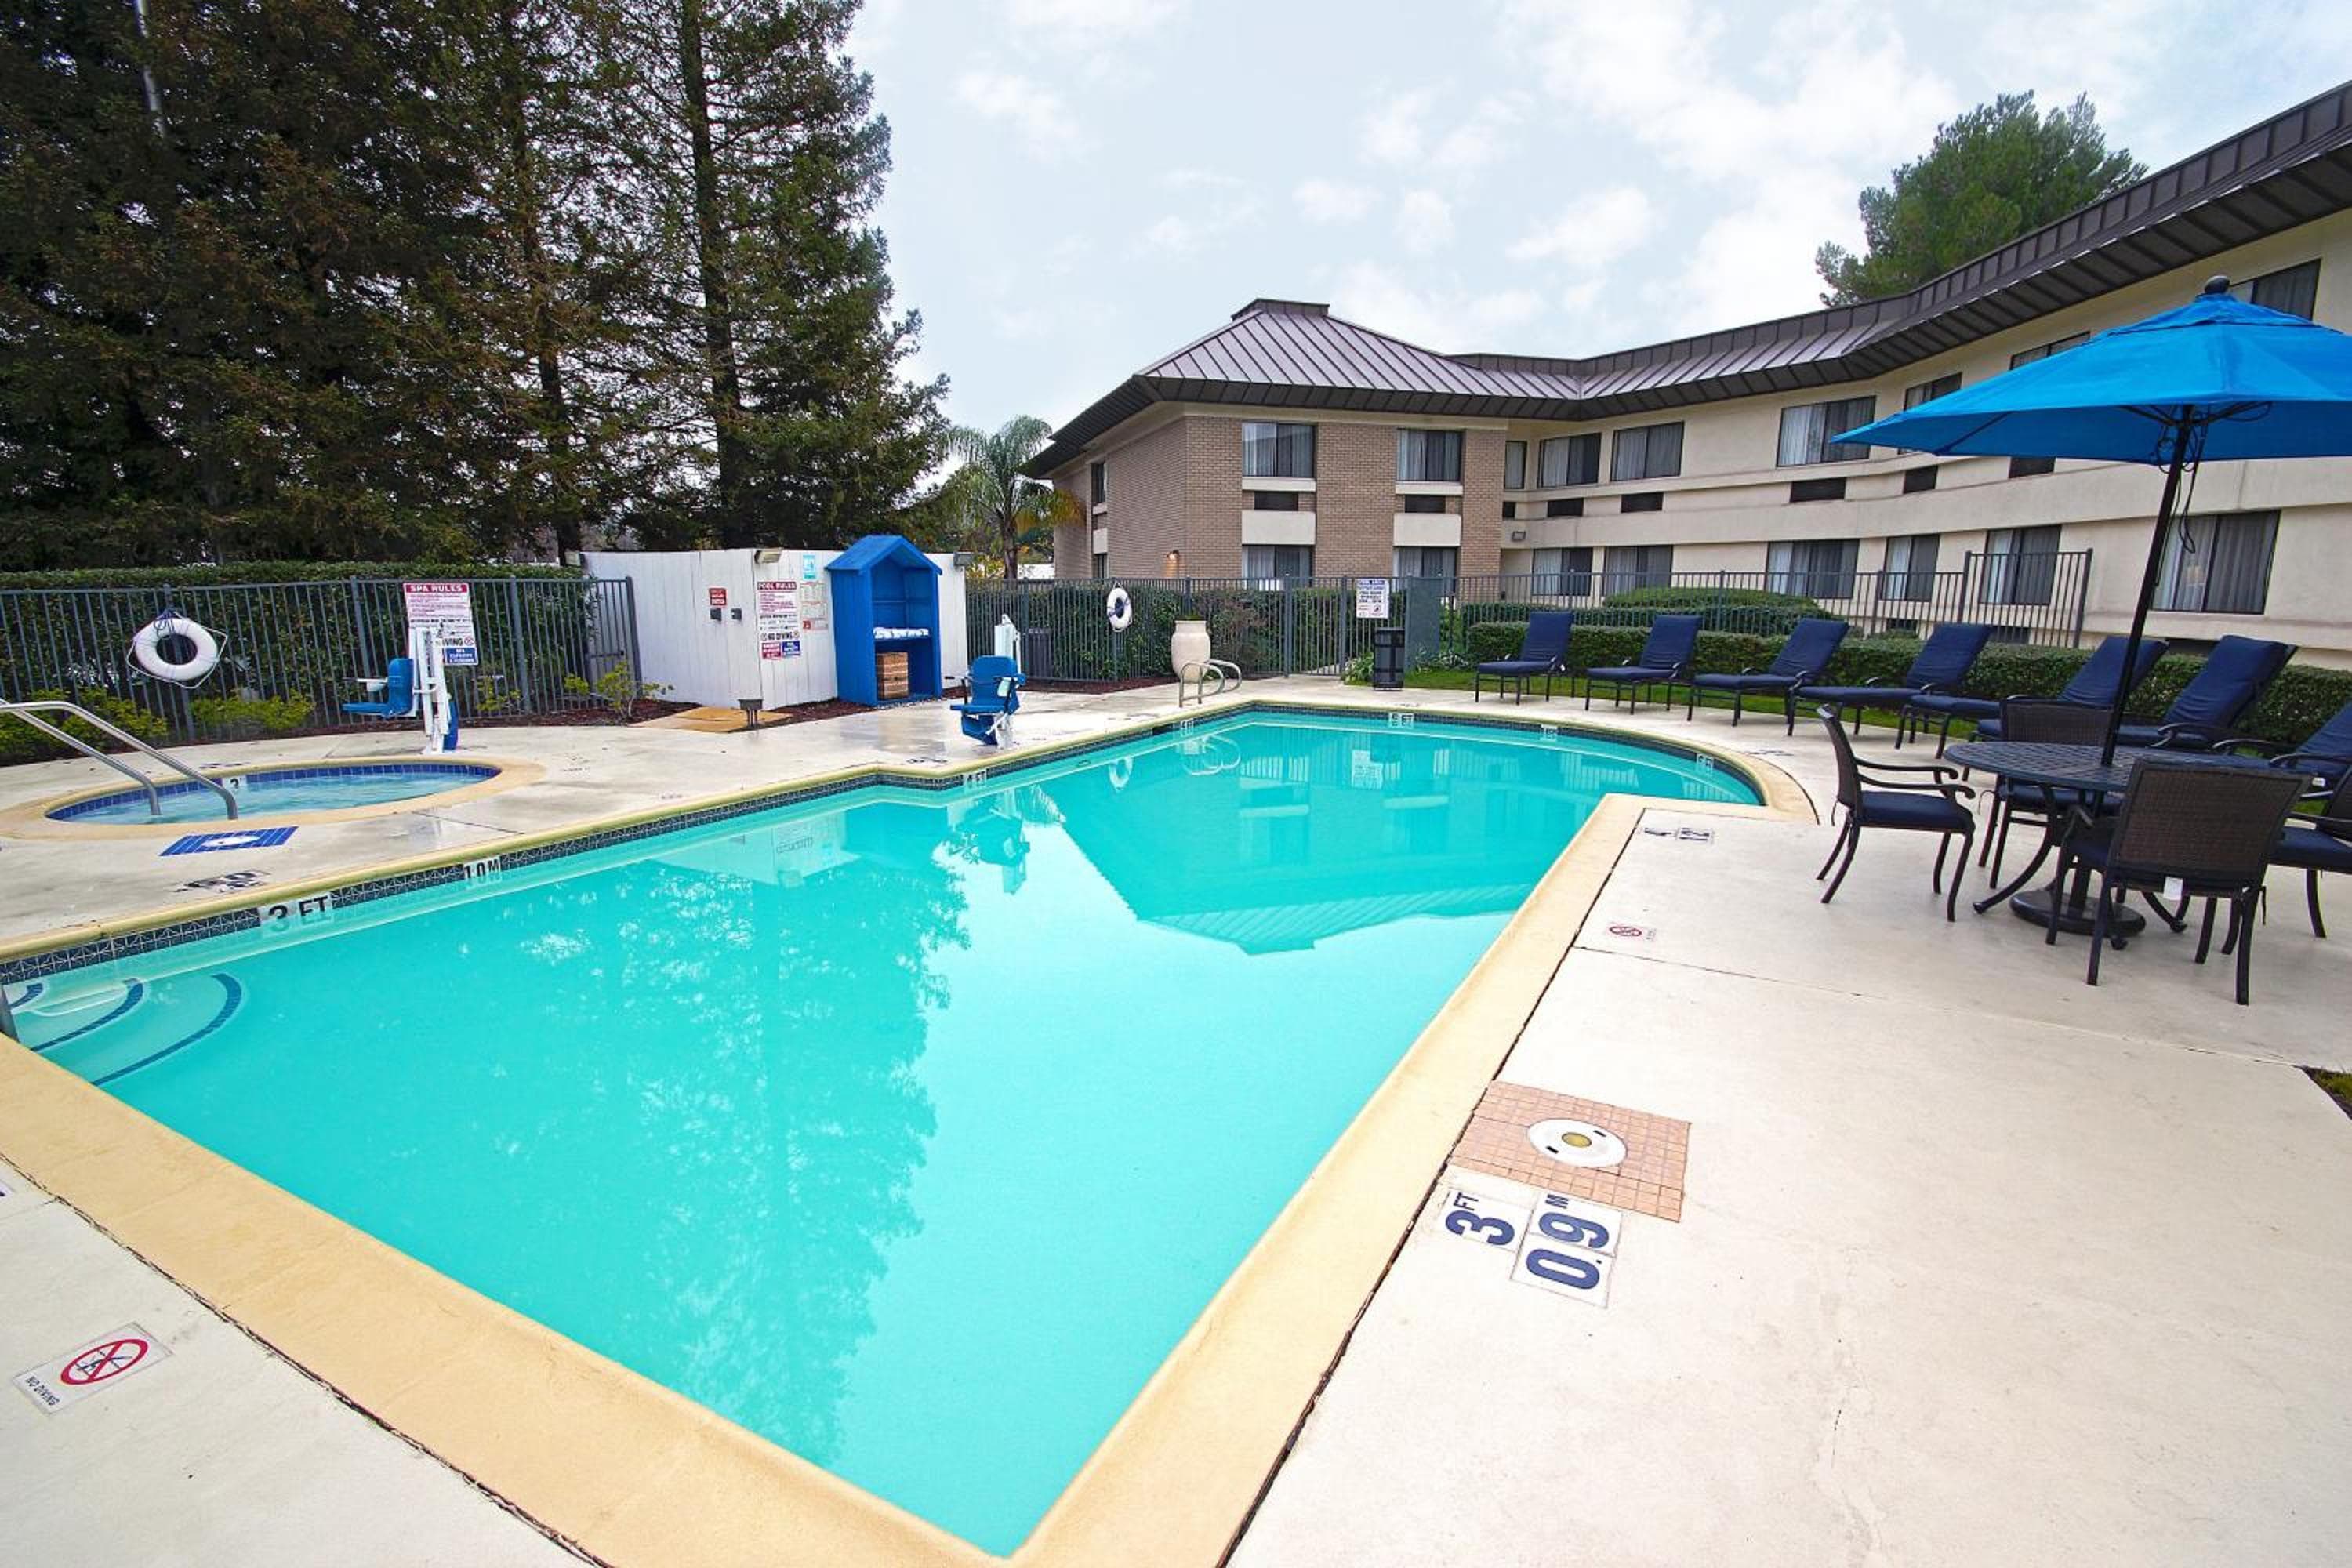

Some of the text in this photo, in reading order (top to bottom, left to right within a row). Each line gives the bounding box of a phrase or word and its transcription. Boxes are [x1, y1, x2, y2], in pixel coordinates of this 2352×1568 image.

[410, 584, 463, 593] SPA RULES
[1445, 1210, 1515, 1246] 3
[25, 1376, 60, 1406] NO DIVING
